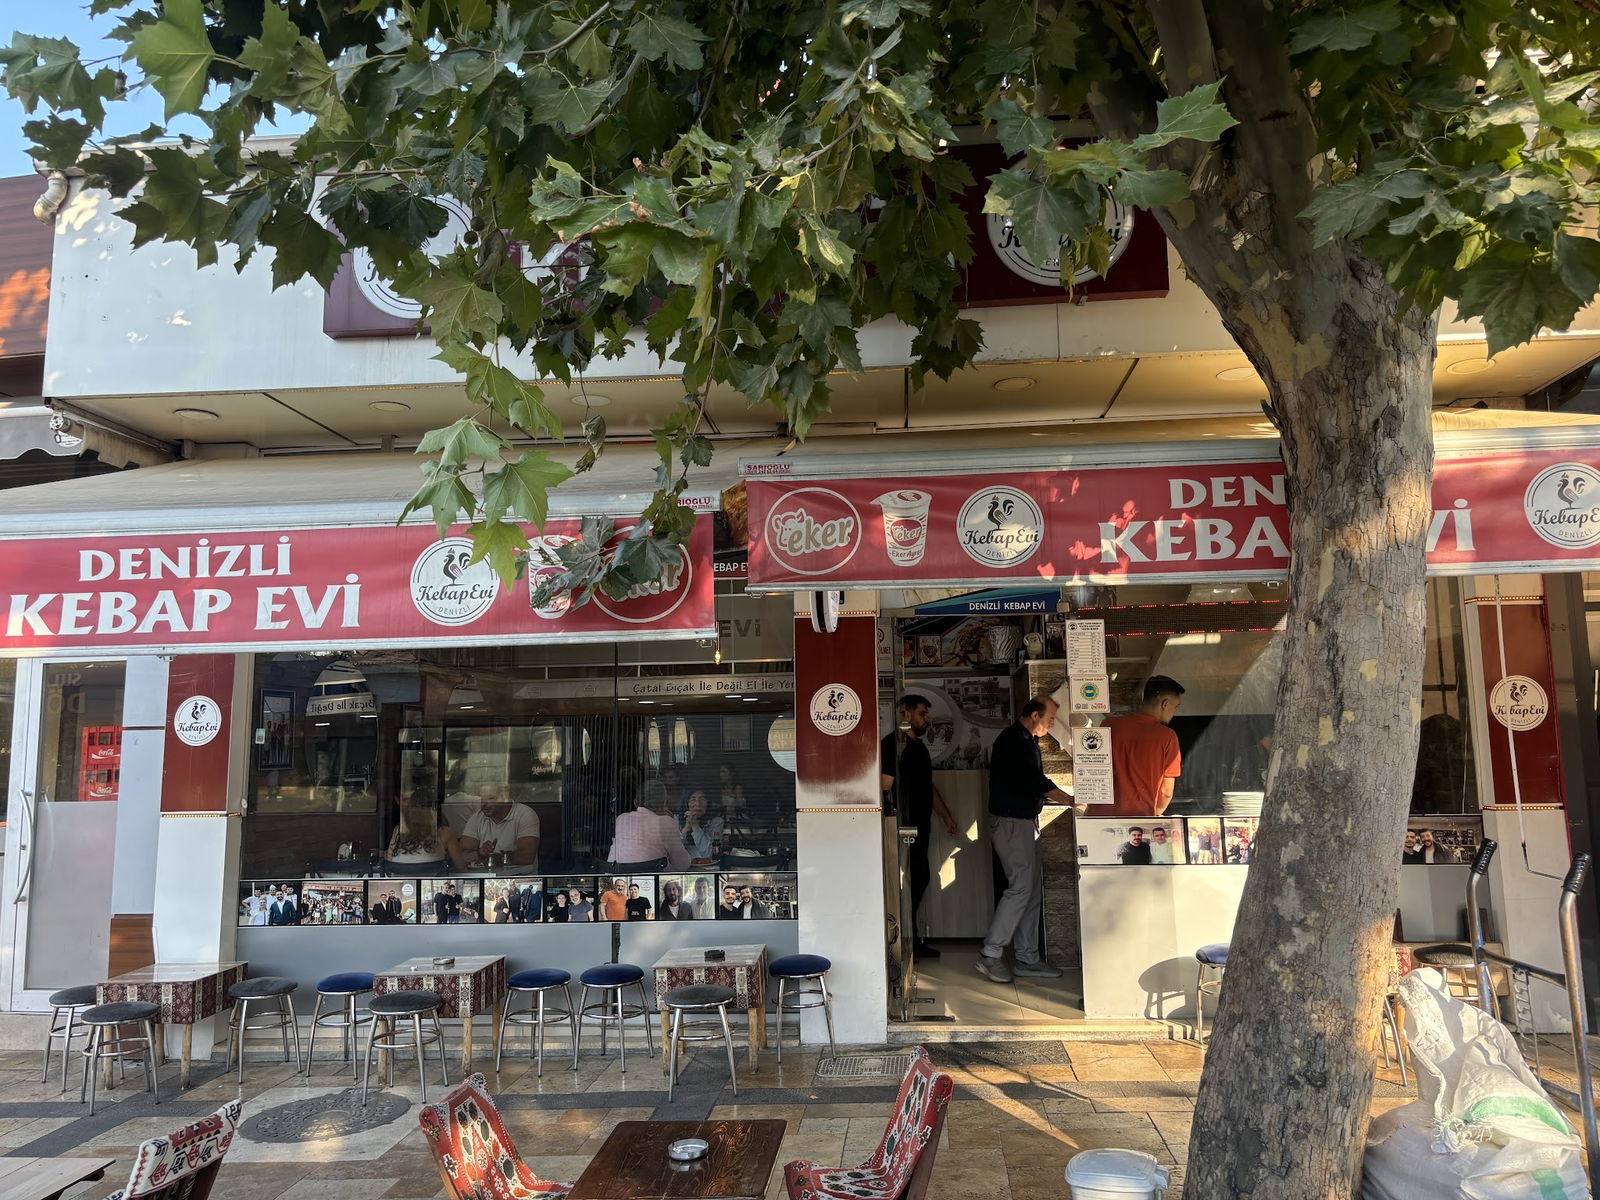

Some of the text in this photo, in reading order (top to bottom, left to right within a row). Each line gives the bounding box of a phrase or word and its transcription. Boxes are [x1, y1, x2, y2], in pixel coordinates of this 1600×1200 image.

[1532, 507, 1600, 528] KebapE
[1098, 516, 1292, 563] KEBA
[79, 536, 292, 582] DENİZLİ
[713, 562, 739, 572] EBAP
[5, 573, 362, 637] KEBAP EVİ
[1004, 601, 1031, 610] KEBAP
